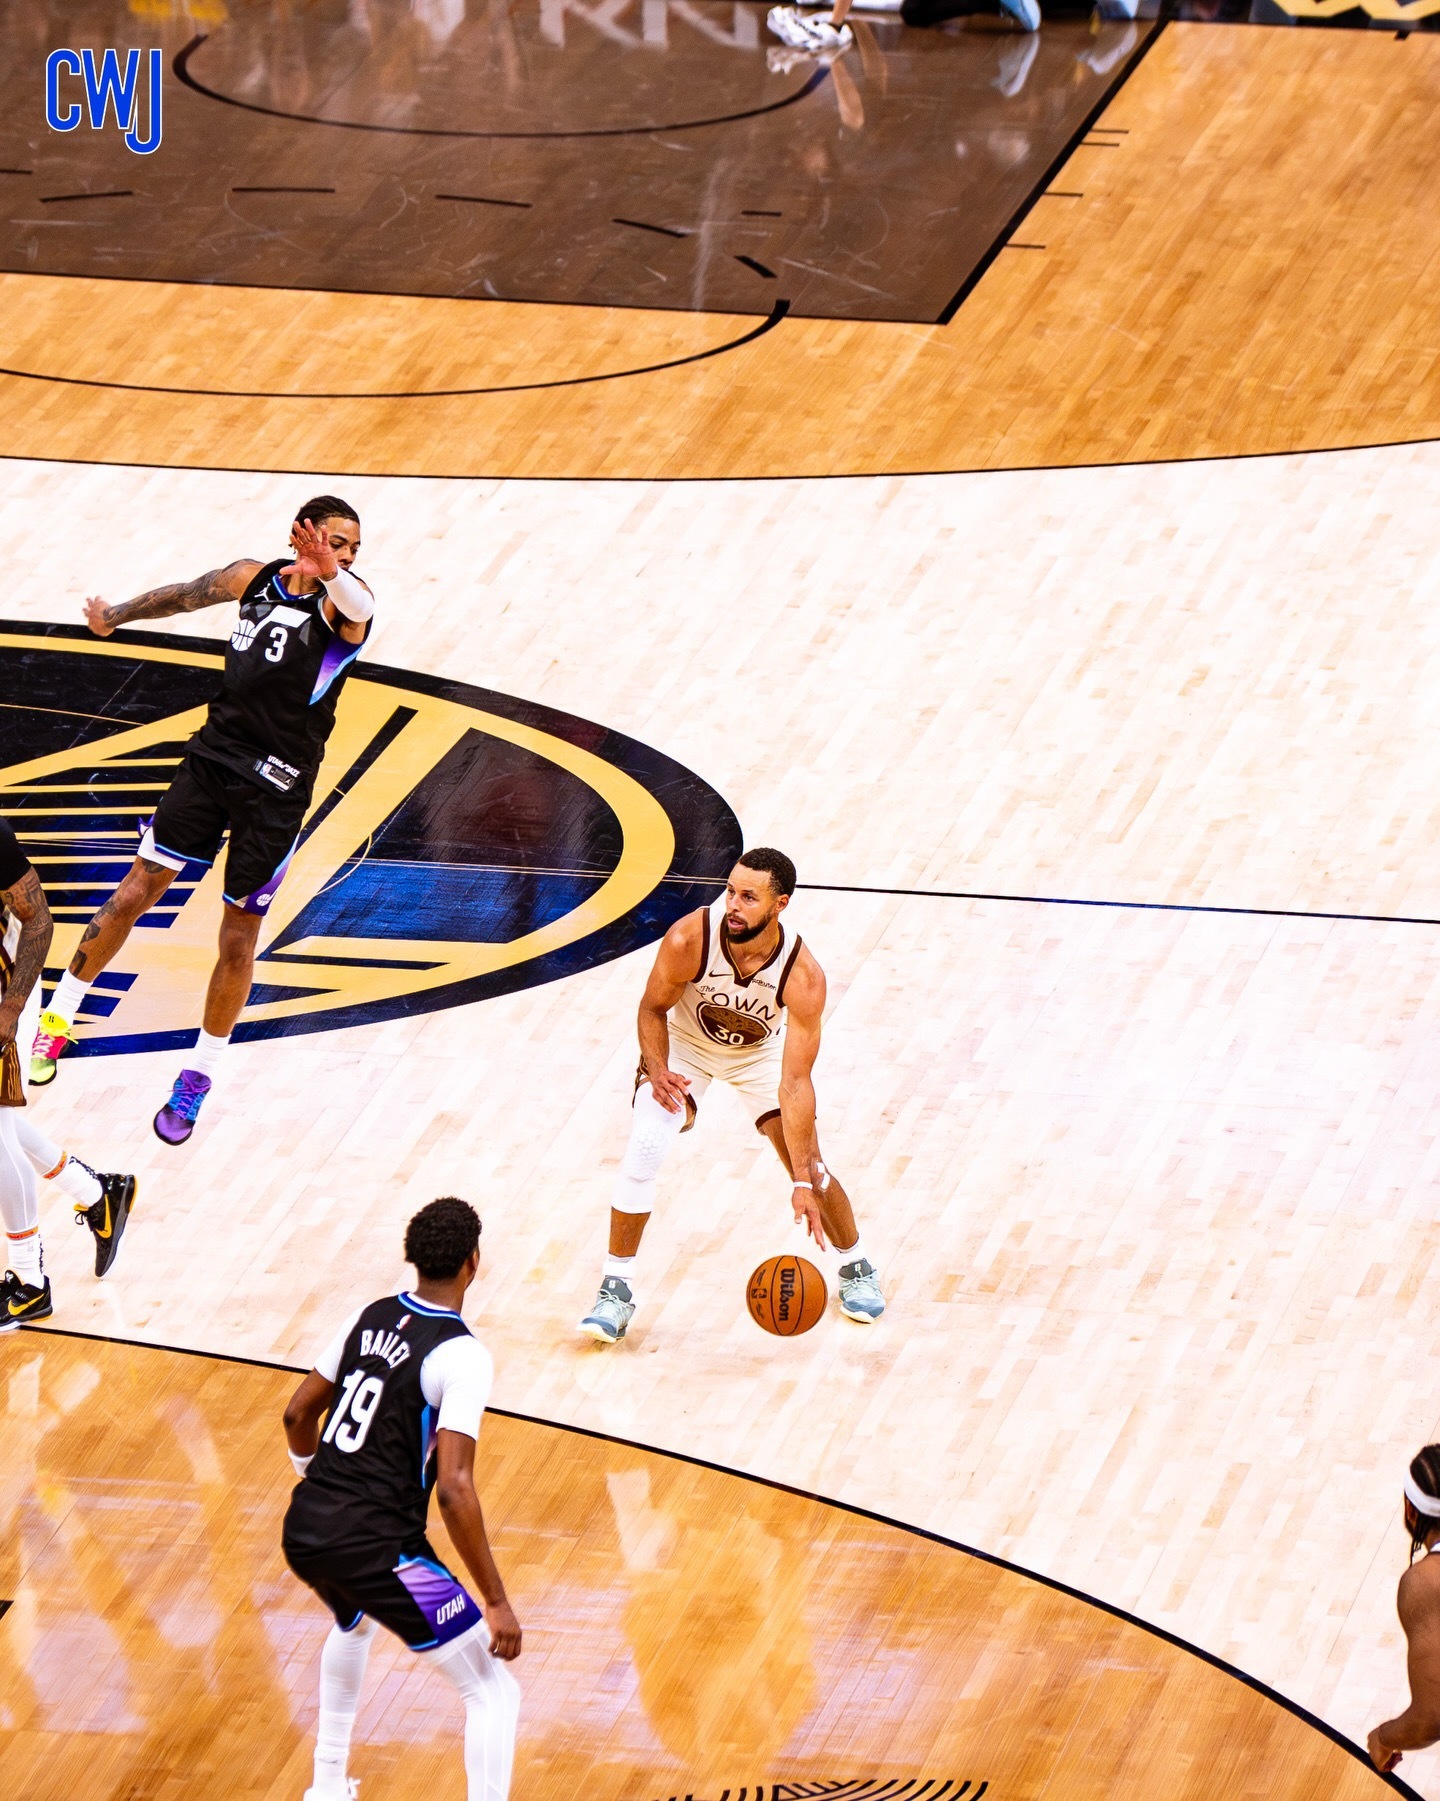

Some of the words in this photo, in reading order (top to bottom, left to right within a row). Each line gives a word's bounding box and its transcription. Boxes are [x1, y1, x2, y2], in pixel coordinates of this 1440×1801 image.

[265, 627, 288, 663] 3
[697, 990, 776, 1021] OWN
[700, 985, 716, 993] The
[714, 1024, 744, 1045] 30
[779, 1267, 795, 1321] Wilson
[360, 1329, 411, 1369] BAILEY
[322, 1369, 384, 1452] 19
[436, 1593, 466, 1625] UTAH
